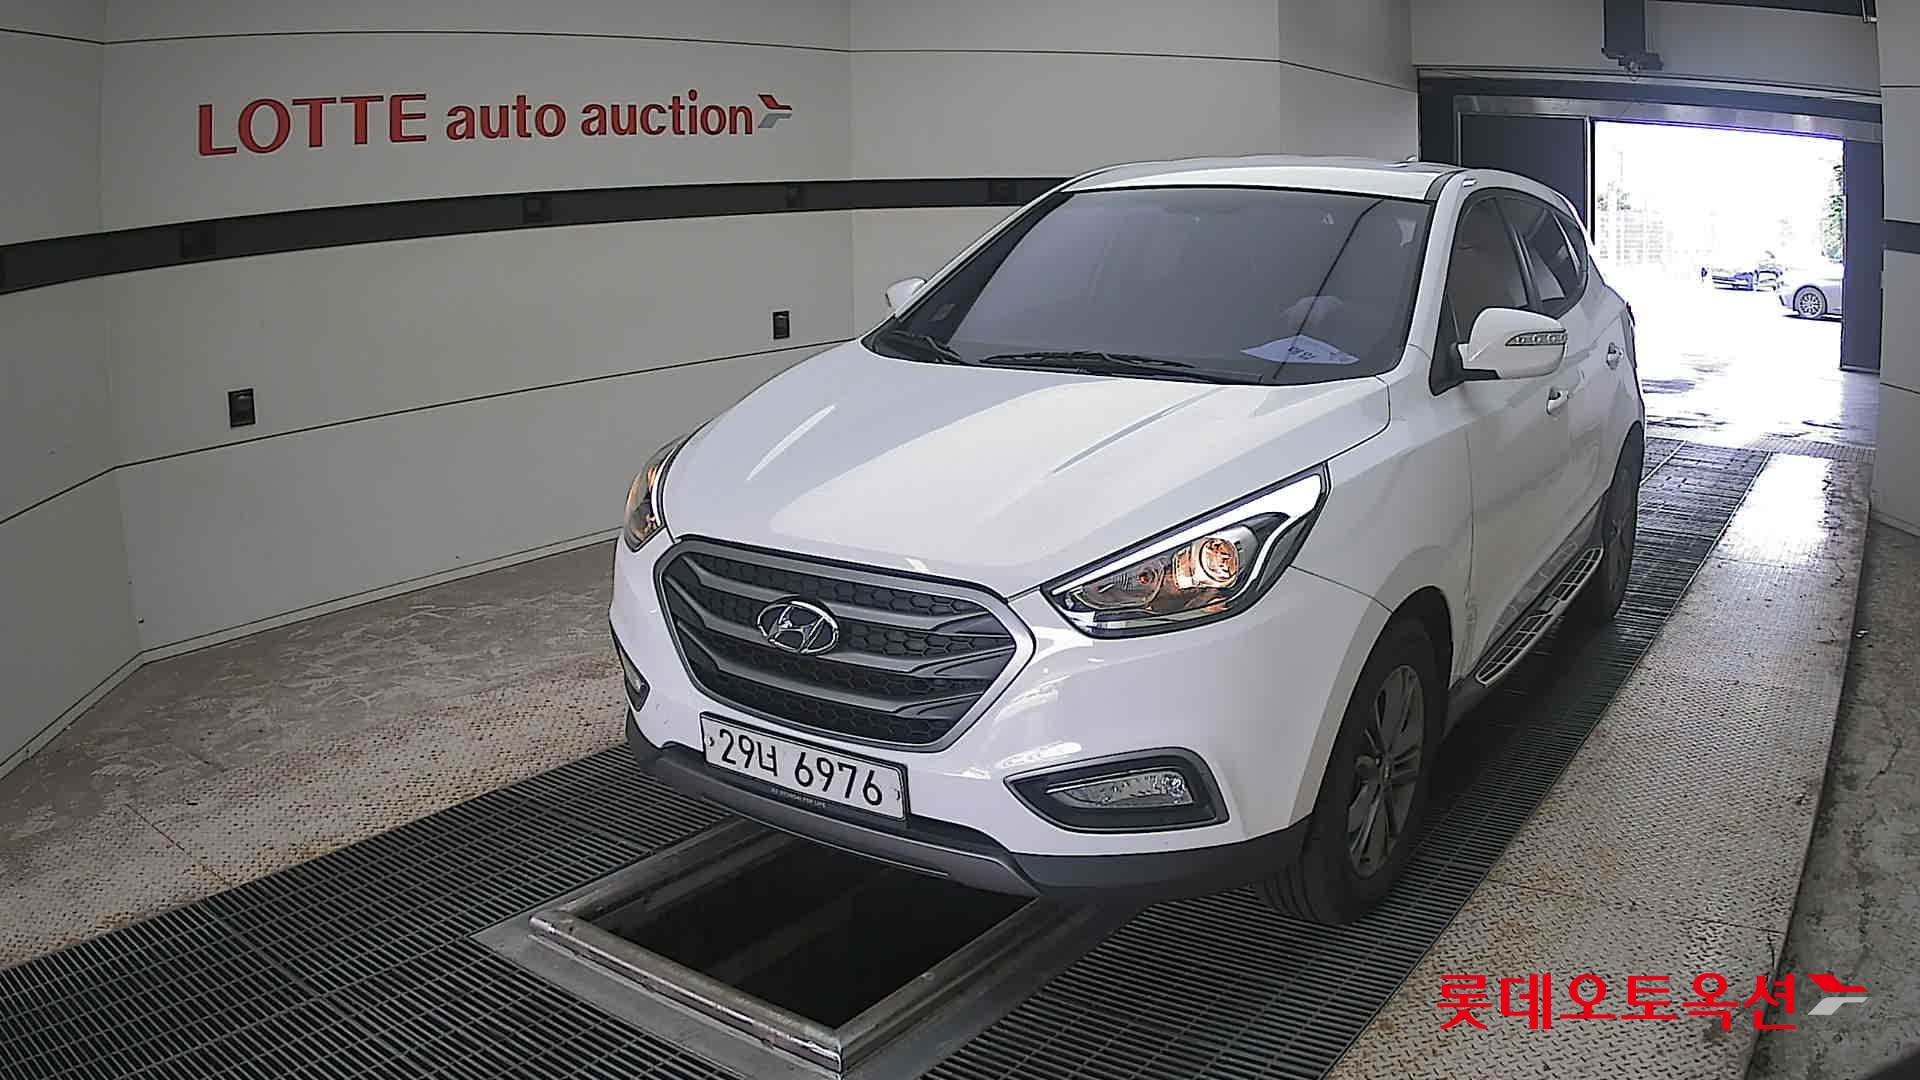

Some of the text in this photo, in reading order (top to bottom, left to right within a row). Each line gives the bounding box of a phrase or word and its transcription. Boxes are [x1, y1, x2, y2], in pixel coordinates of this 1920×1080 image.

[198, 89, 754, 156] LOTTE auto auction
[719, 729, 778, 777] 29너
[794, 752, 883, 806] 6976
